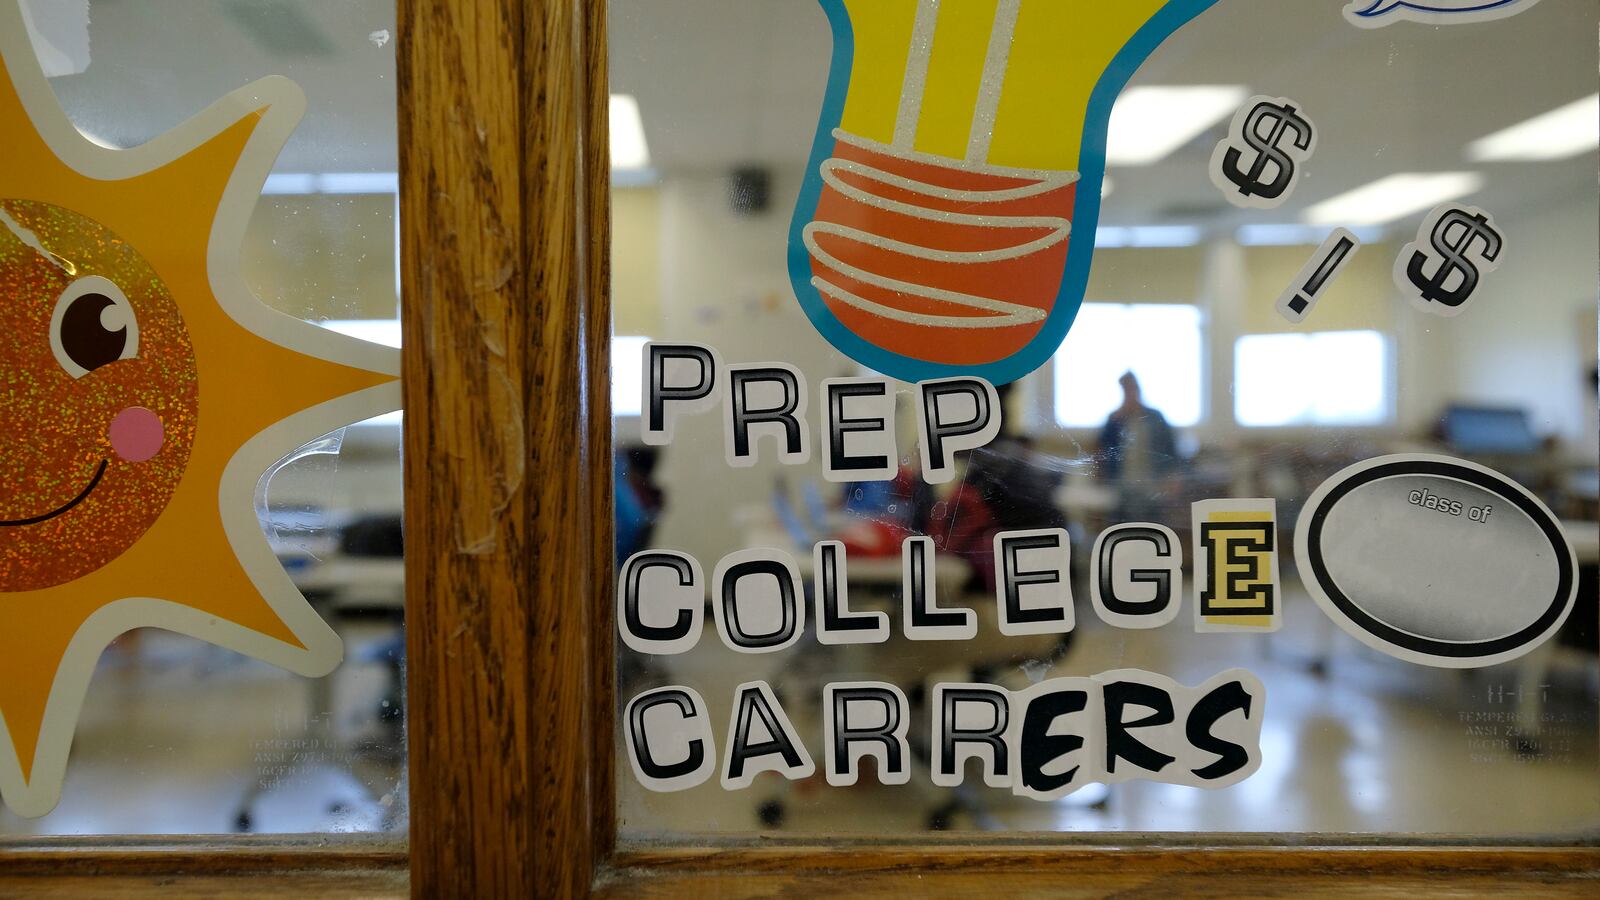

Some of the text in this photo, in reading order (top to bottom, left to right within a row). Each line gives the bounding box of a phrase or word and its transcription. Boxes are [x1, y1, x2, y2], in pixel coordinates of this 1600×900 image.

[1222, 102, 1313, 199] $
[1288, 236, 1355, 314] !
[1407, 209, 1502, 307] $
[650, 344, 992, 470] PREP
[1408, 488, 1493, 523] class of
[624, 521, 1275, 648] COLLEGE
[629, 680, 1253, 792] CARRERS
